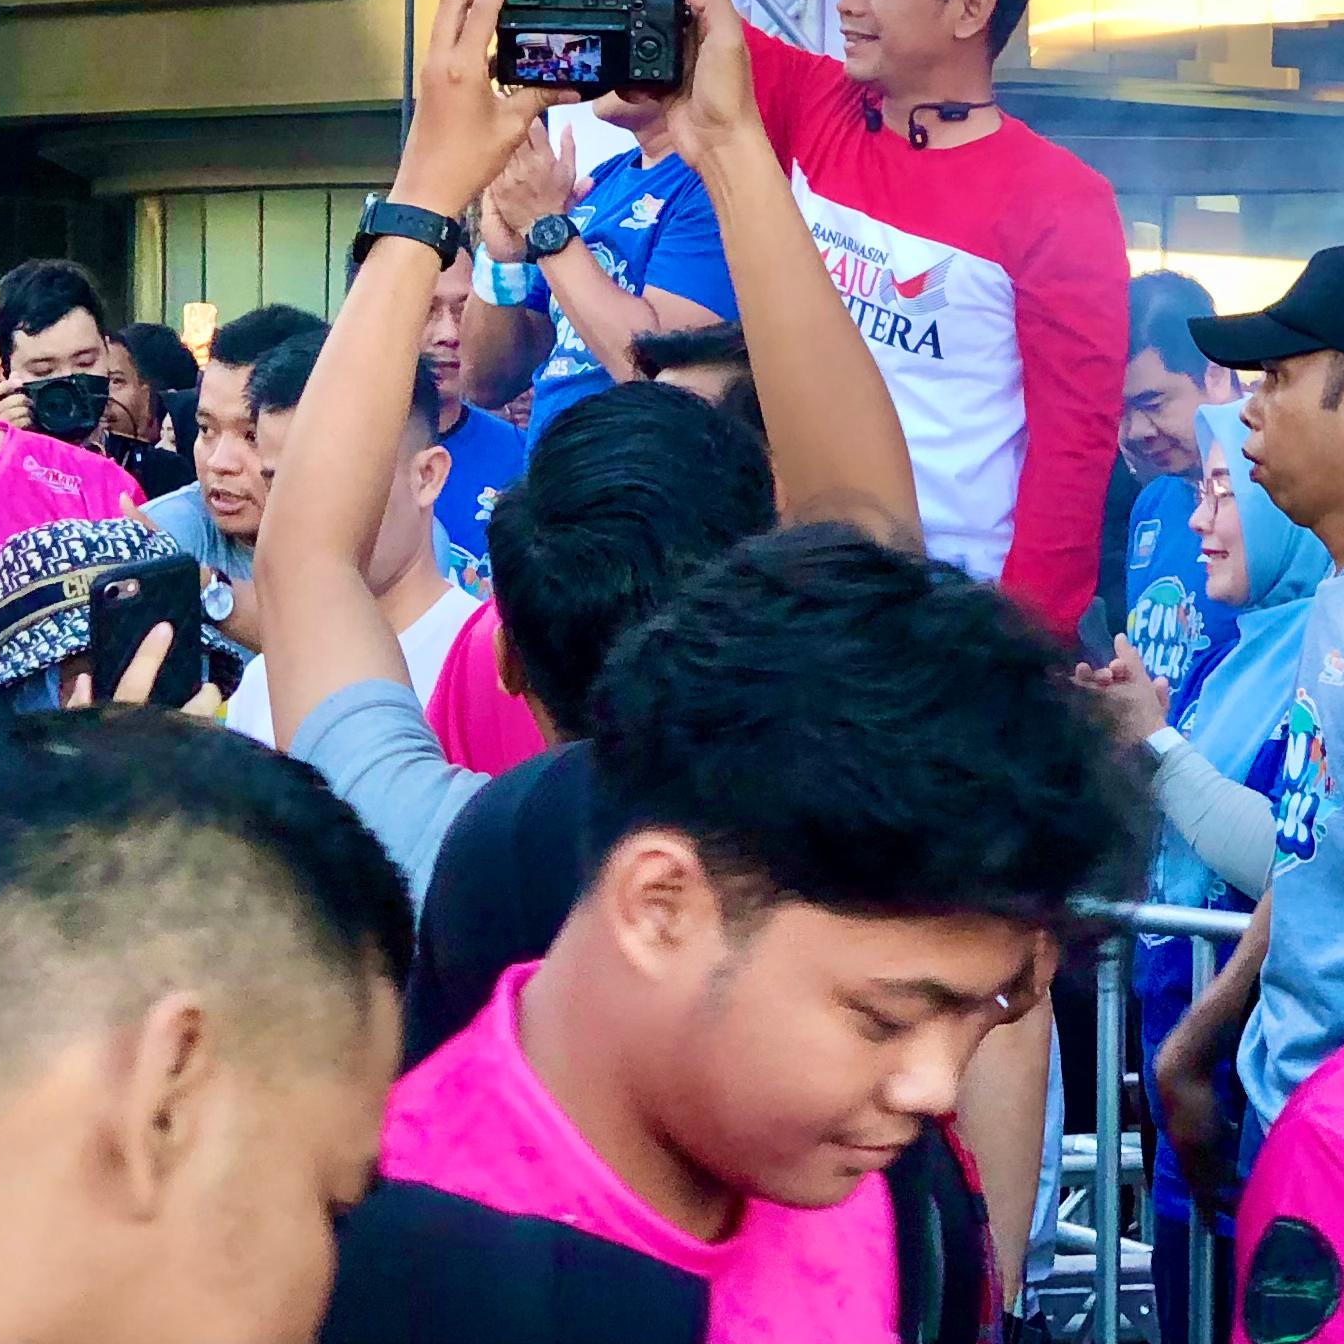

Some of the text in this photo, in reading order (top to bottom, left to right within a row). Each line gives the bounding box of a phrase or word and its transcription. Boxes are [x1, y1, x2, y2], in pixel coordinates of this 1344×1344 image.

[811, 222, 890, 265] BANJARMASIN
[820, 246, 882, 298] AJU
[1134, 598, 1178, 641] FUN
